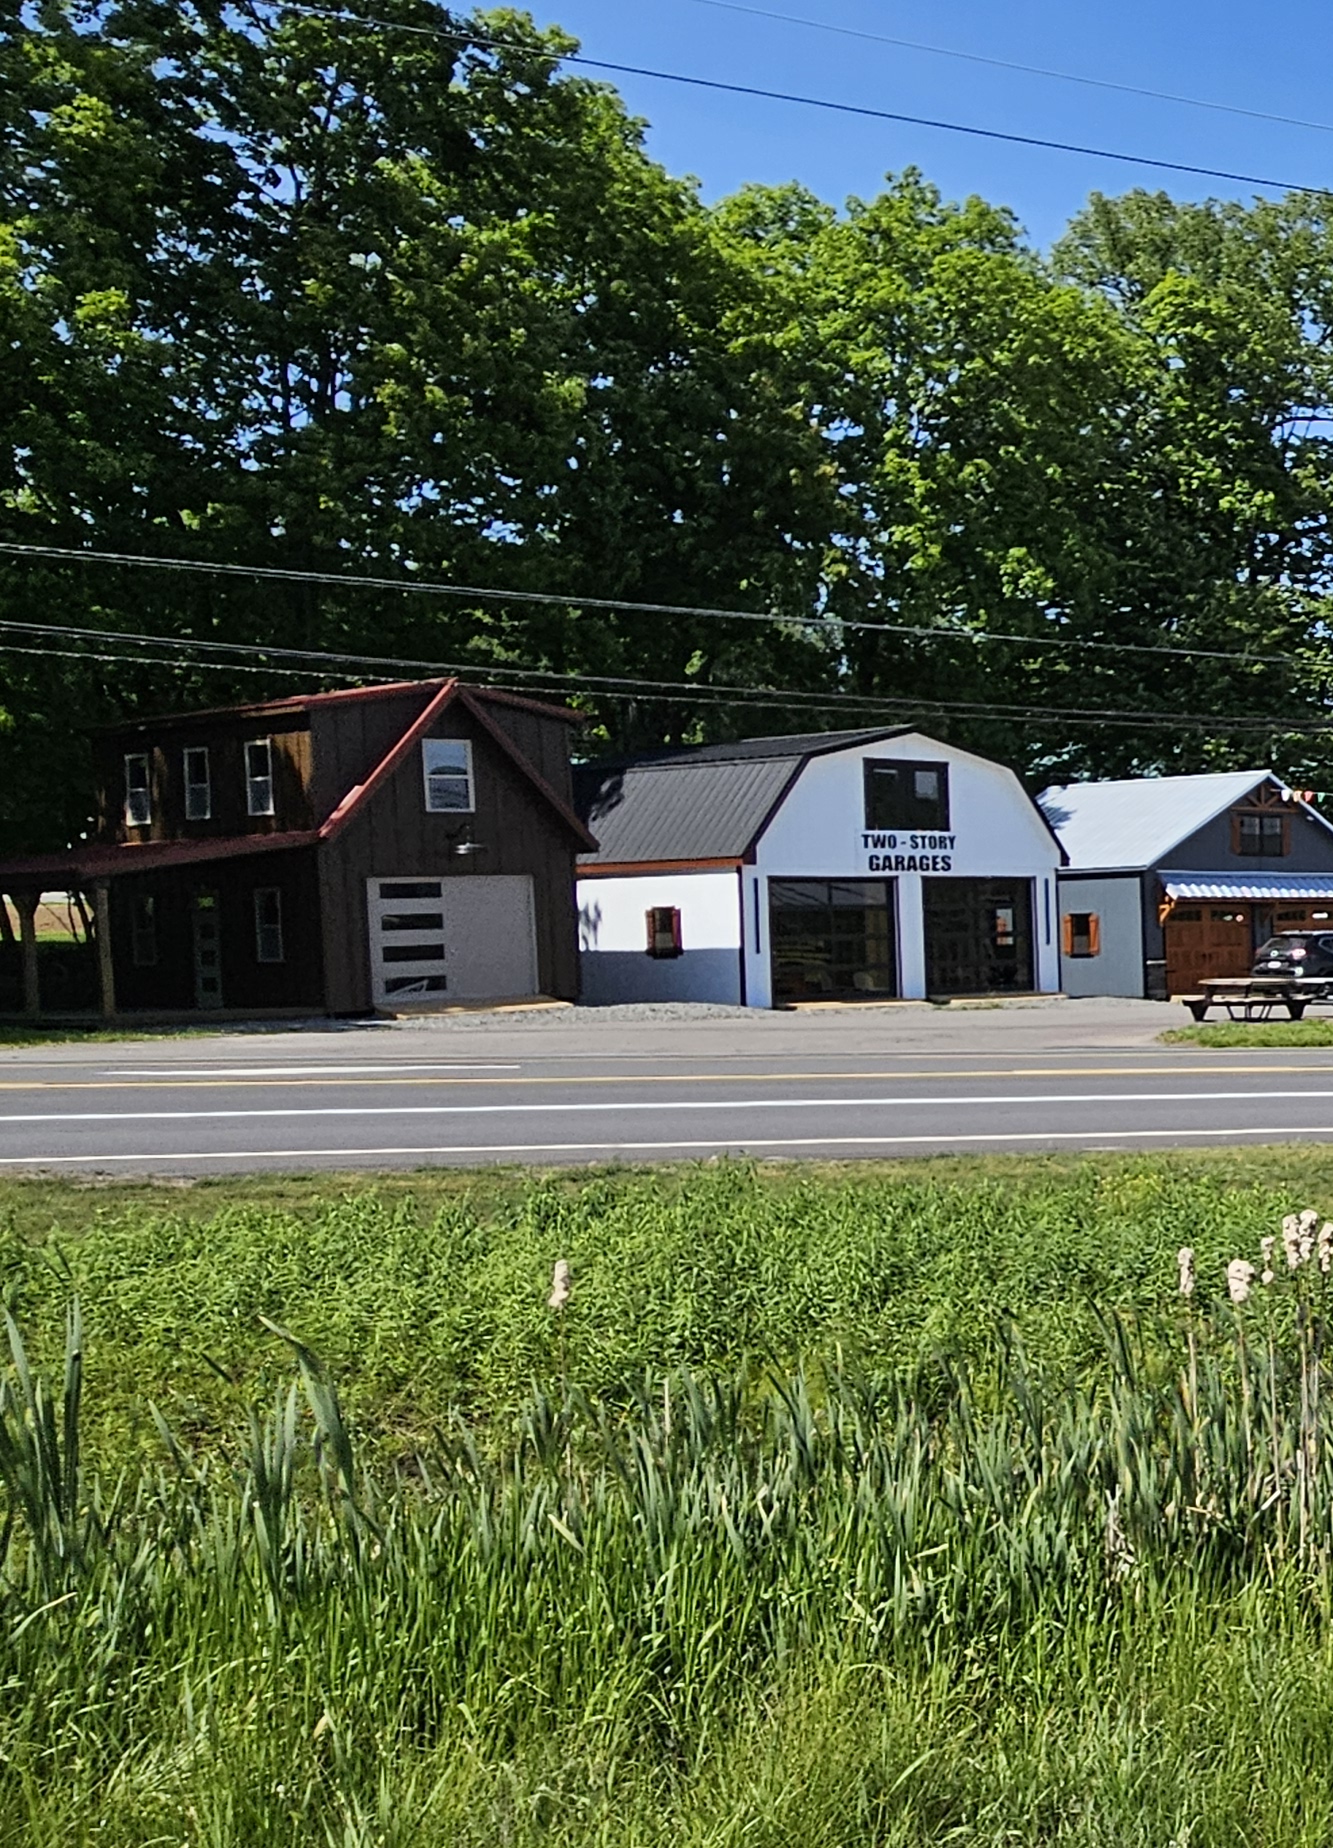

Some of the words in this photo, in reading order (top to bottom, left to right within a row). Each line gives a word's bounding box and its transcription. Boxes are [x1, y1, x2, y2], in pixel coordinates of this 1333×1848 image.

[861, 834, 897, 849] TWO
[909, 834, 956, 850] STORY
[868, 854, 952, 872] GARAGES
